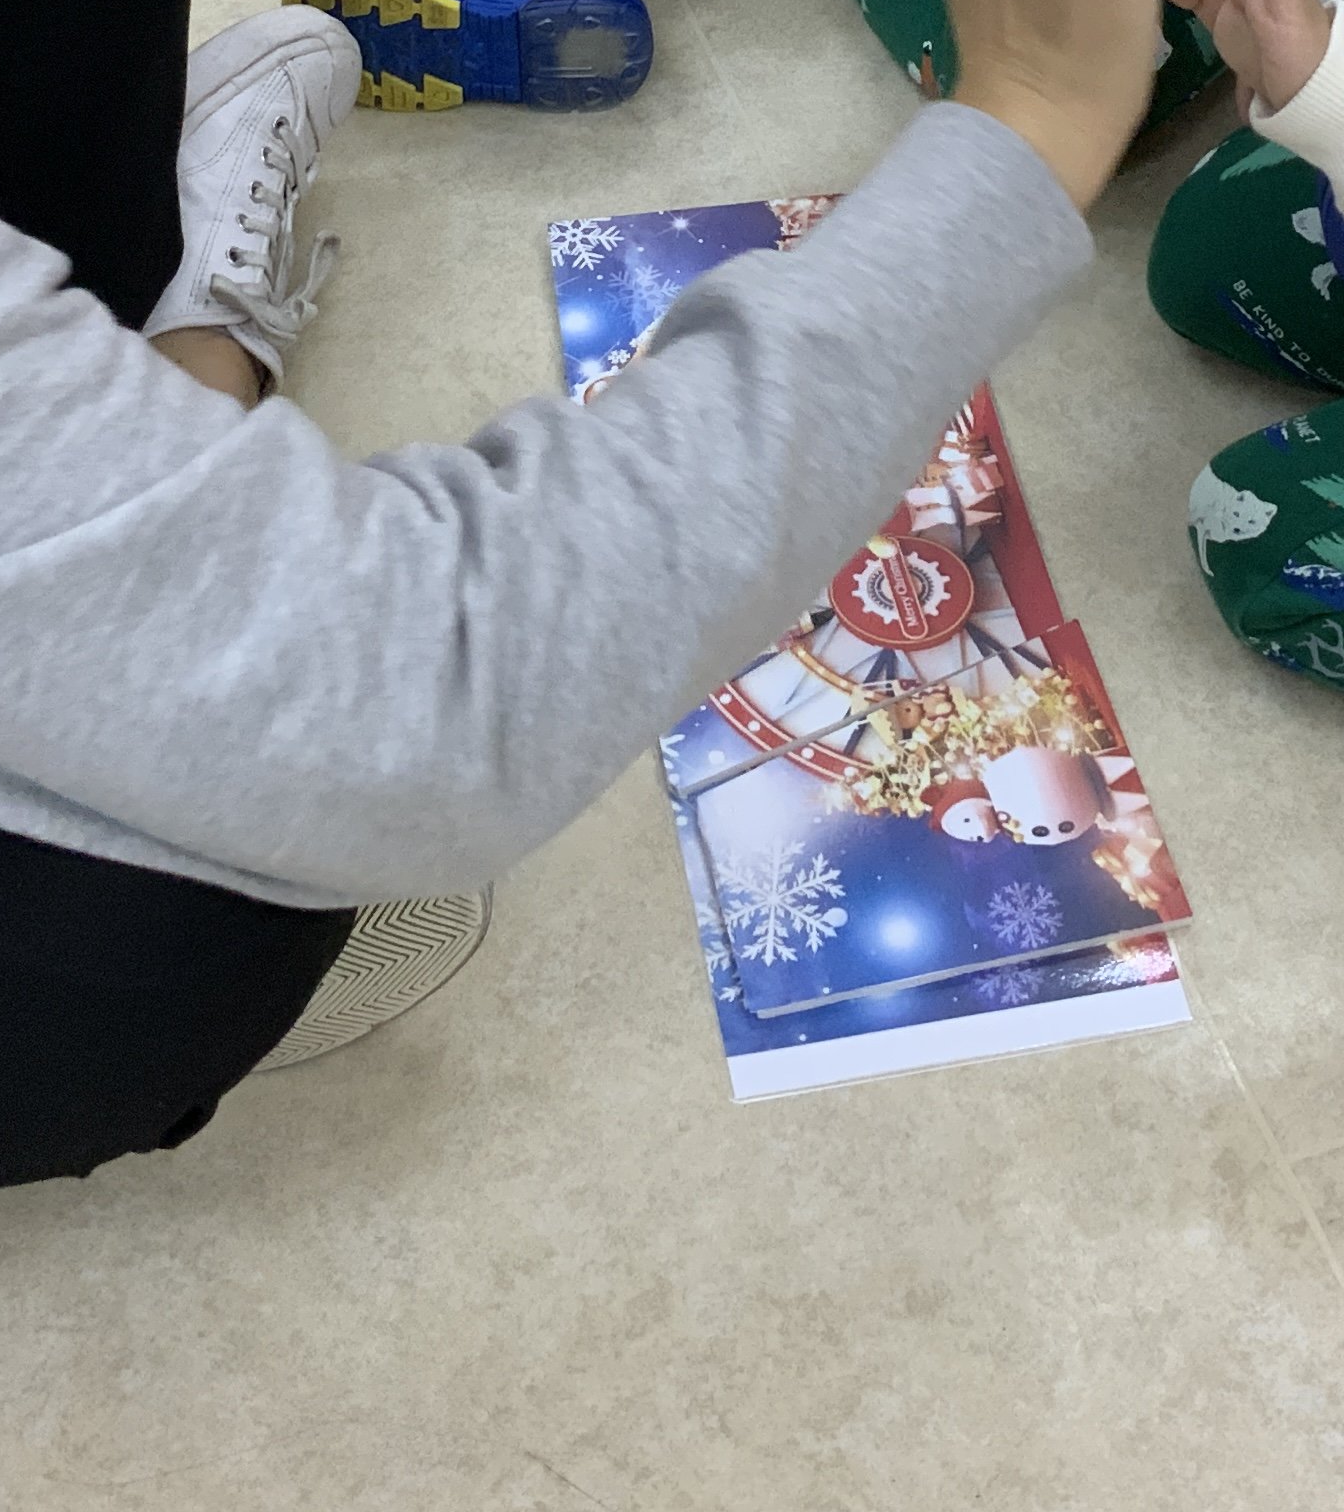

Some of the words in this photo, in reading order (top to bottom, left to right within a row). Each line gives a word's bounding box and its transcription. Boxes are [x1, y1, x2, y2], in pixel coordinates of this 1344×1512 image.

[1232, 279, 1254, 300] BE
[1252, 304, 1285, 339] KIND
[1290, 341, 1311, 362] TO
[902, 596, 920, 628] Merry
